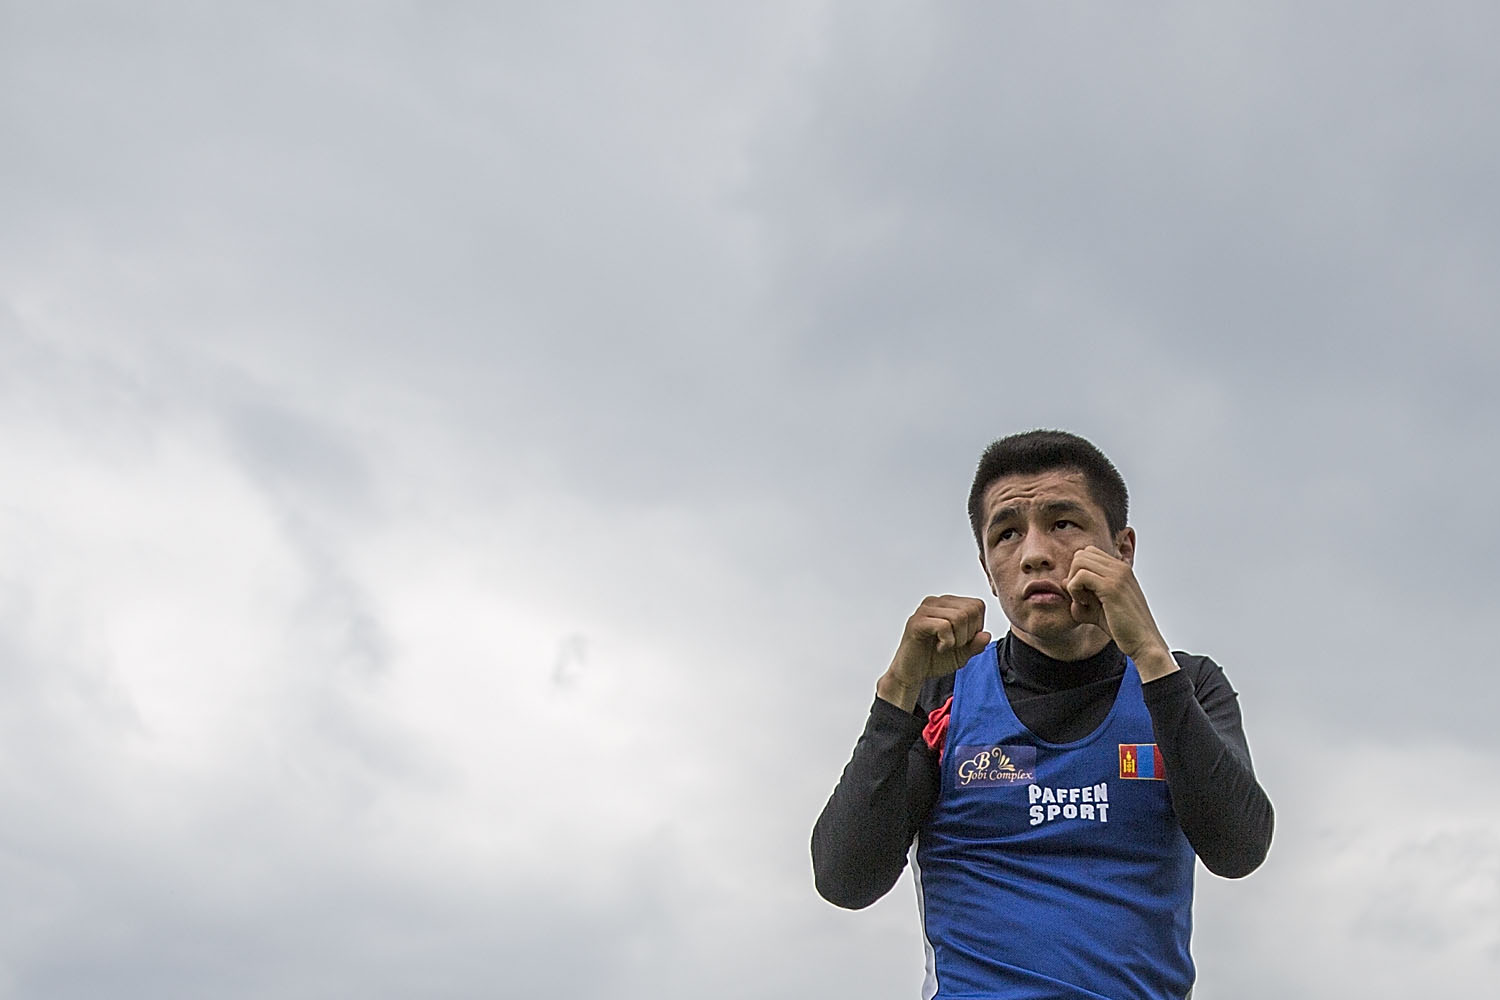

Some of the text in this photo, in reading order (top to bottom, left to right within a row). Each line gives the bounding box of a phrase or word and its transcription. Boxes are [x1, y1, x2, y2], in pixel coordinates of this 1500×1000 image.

[958, 759, 1034, 785] Gobi Complex
[1028, 782, 1108, 804] PAFFEN
[1029, 803, 1109, 826] SPORT
